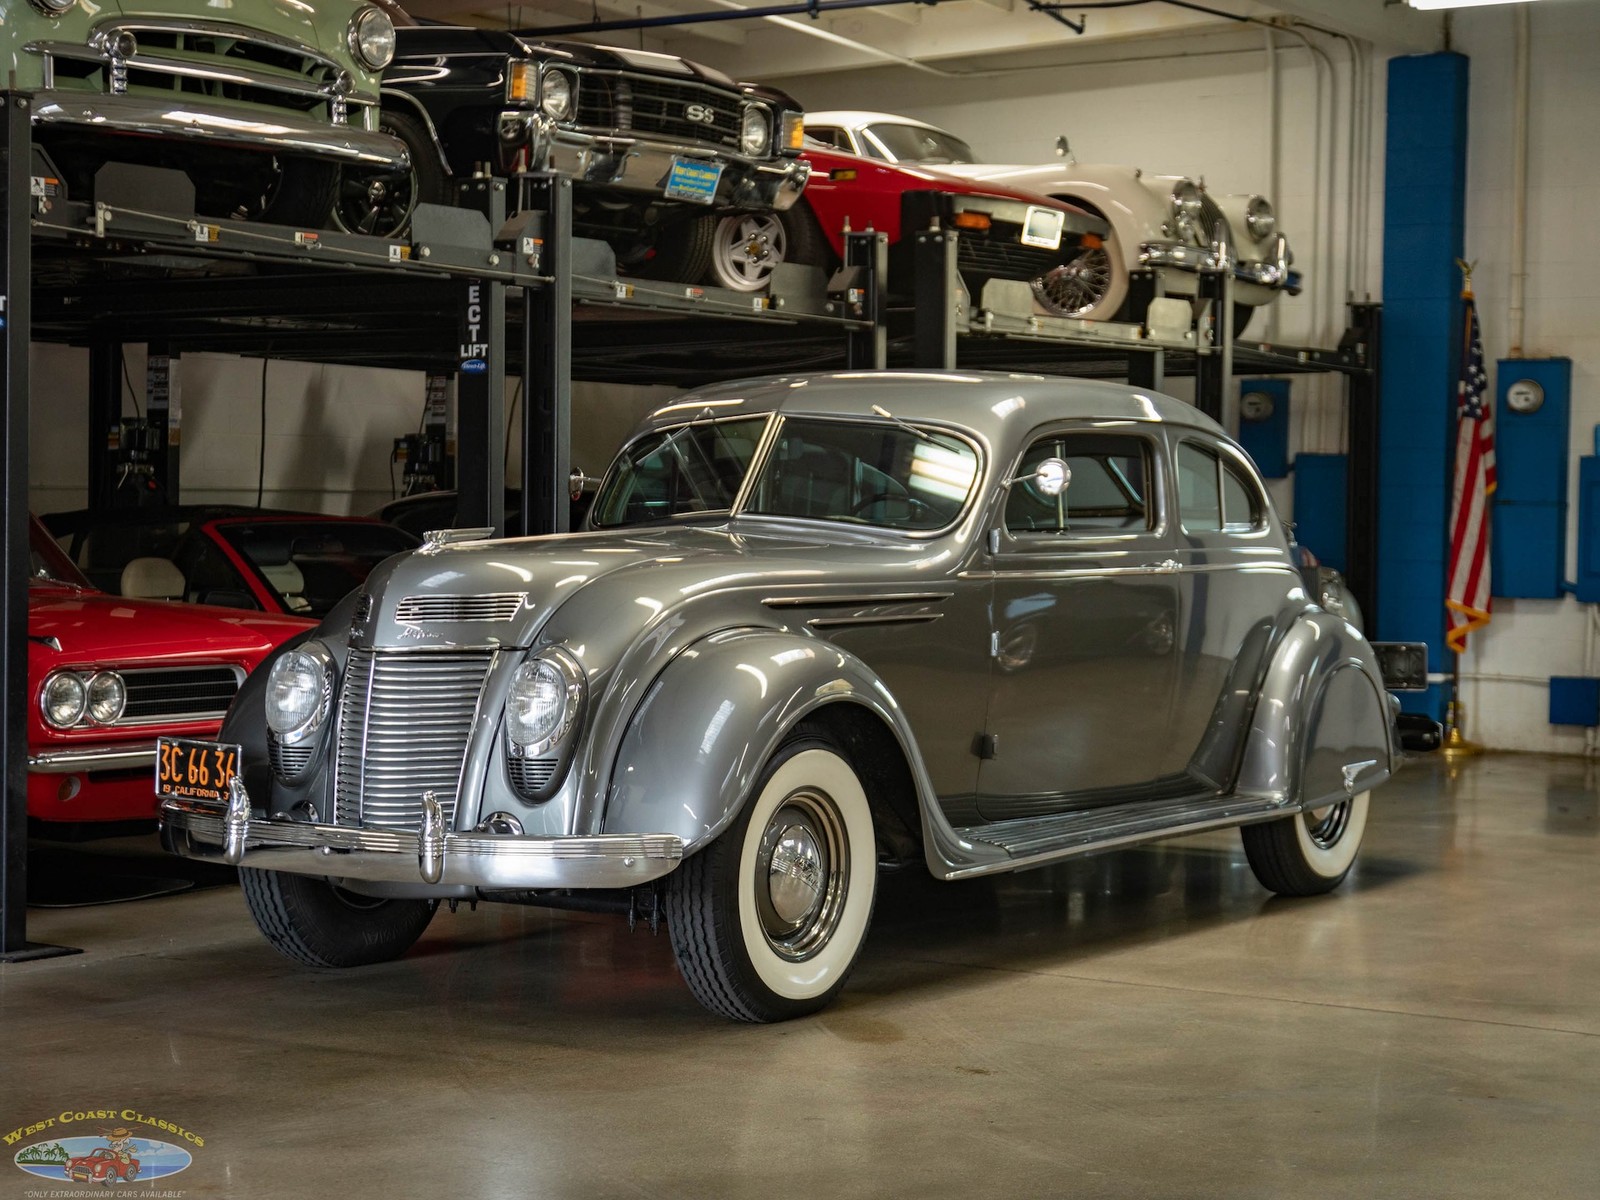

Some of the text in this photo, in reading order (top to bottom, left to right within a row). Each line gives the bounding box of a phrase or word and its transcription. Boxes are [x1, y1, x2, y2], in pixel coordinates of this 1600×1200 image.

[687, 105, 714, 124] SS
[468, 281, 481, 342] ECT
[460, 344, 488, 358] LIFT
[160, 745, 183, 782] 3C
[188, 748, 209, 785] 66
[163, 784, 230, 800] 19 CALIFORNIA 3
